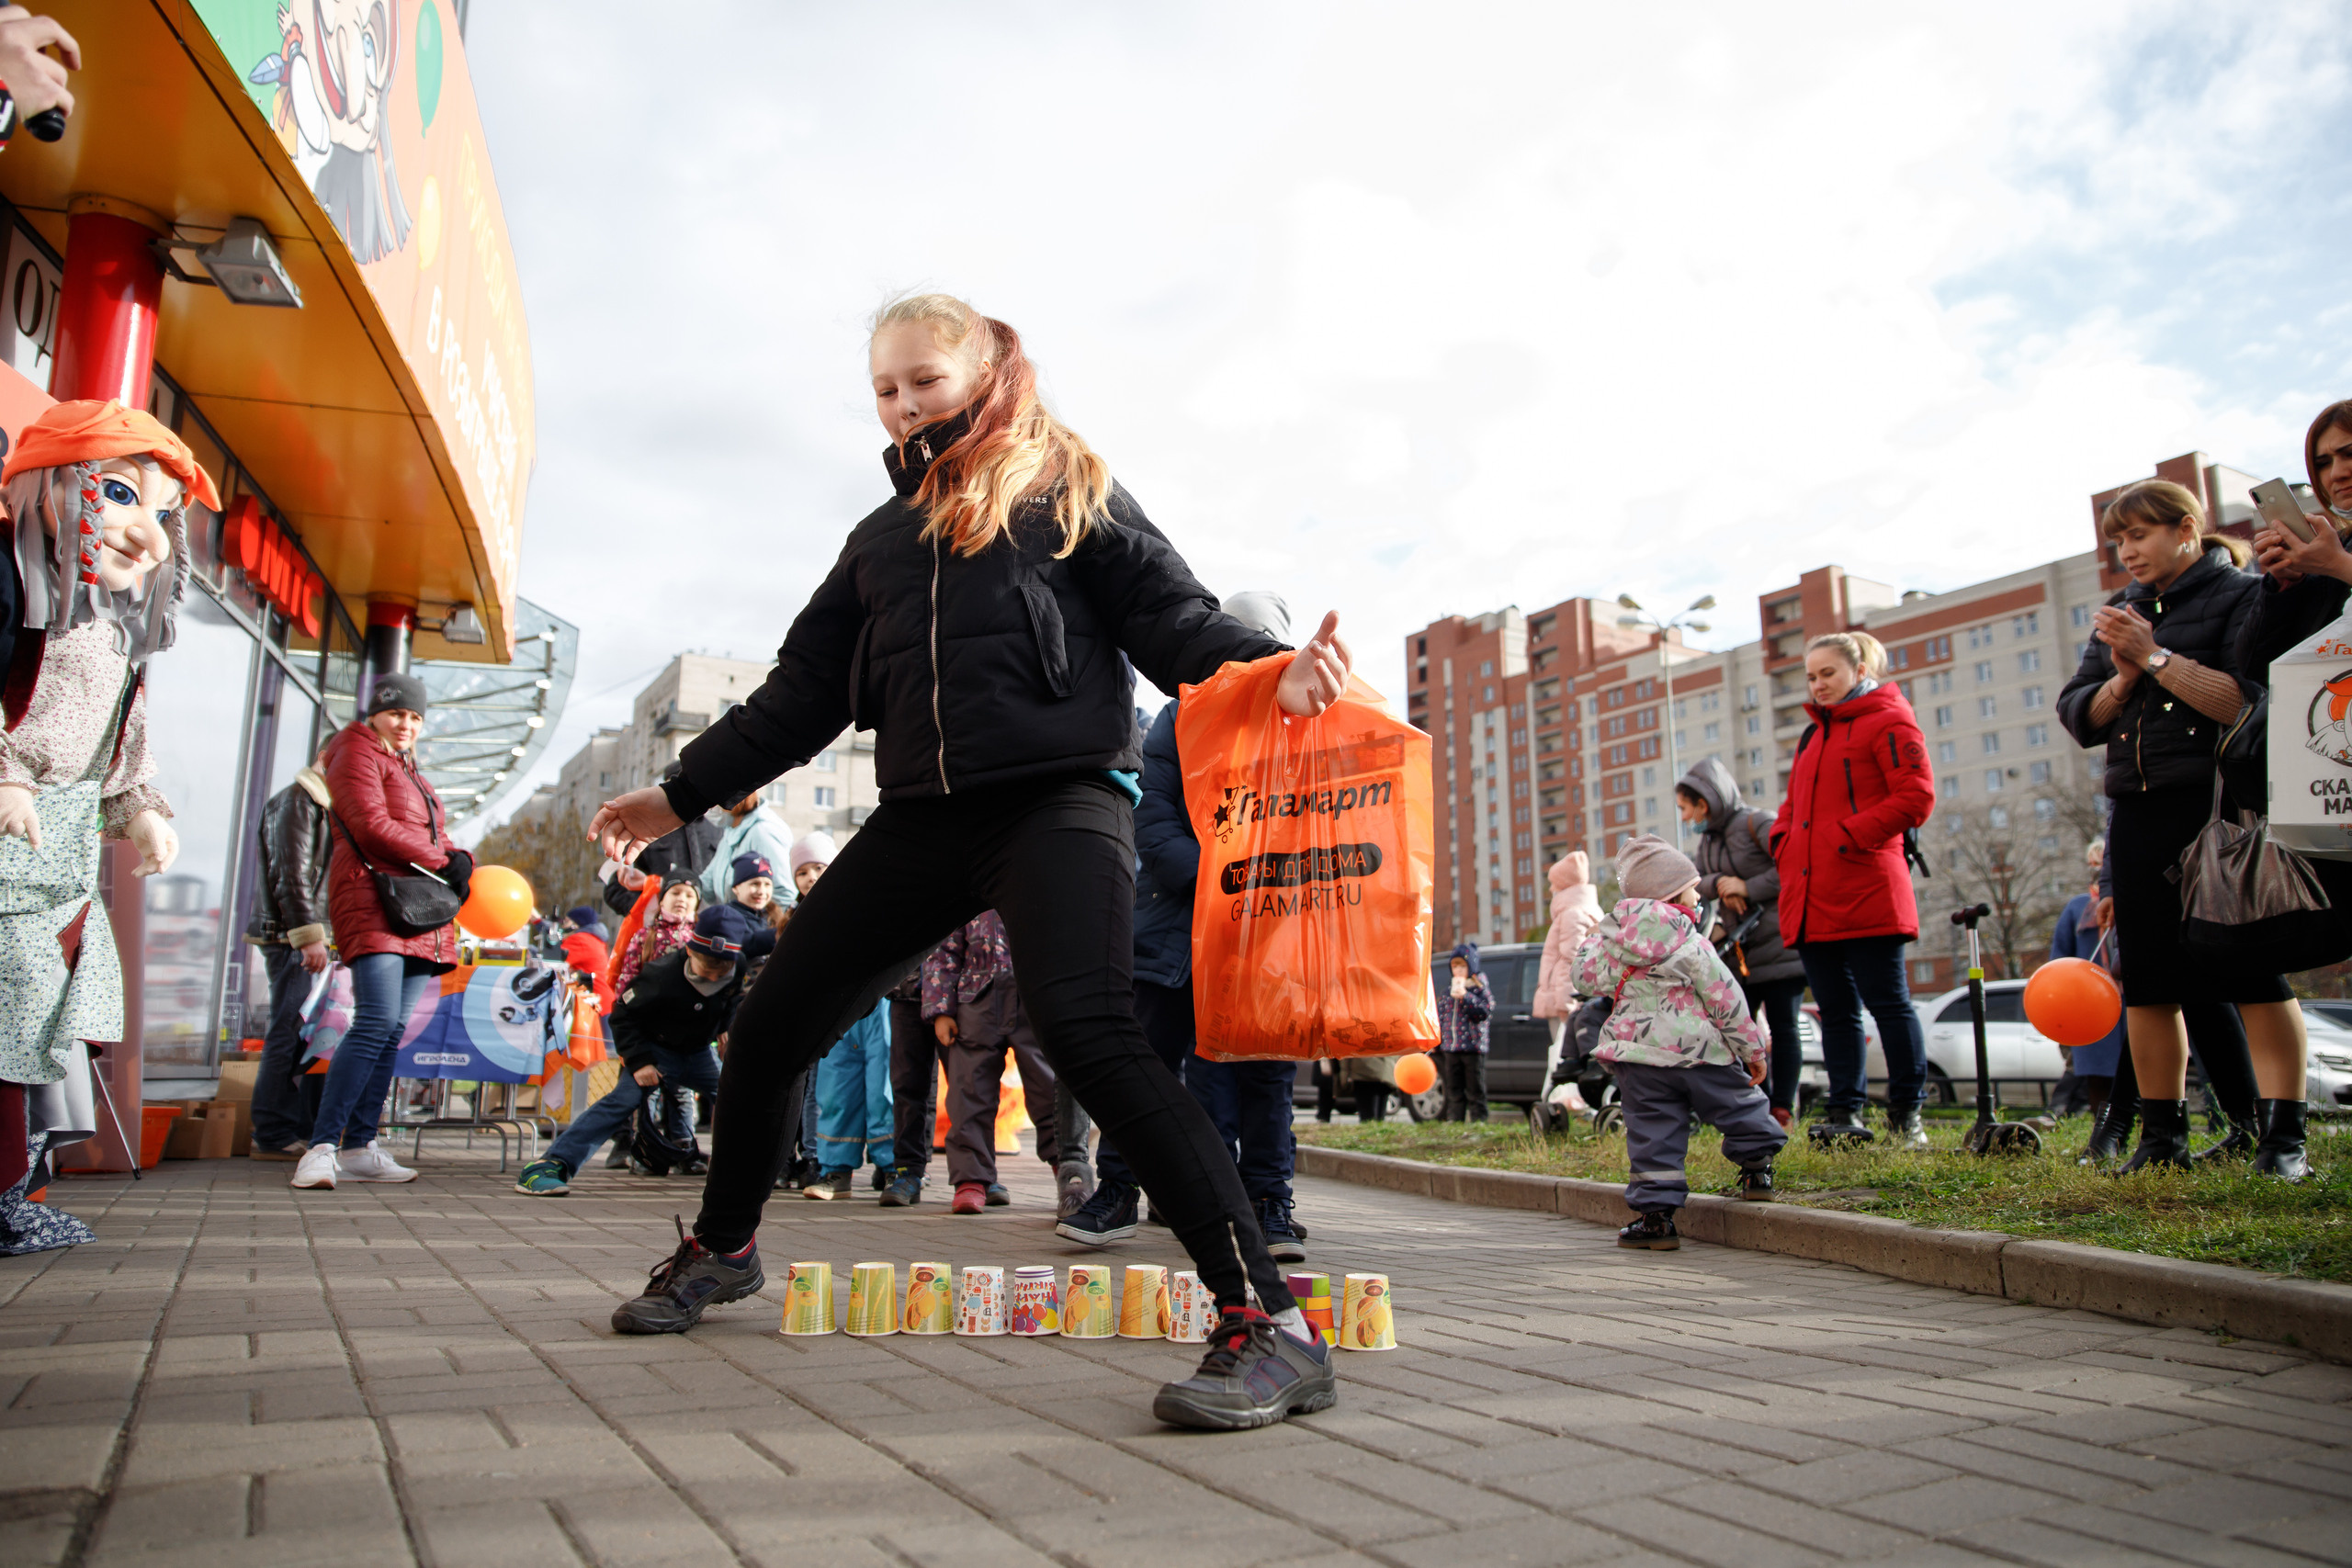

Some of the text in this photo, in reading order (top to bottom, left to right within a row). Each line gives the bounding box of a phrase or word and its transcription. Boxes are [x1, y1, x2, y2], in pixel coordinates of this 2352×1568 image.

[426, 286, 443, 354] В
[1237, 781, 1392, 826] Галамарт
[2310, 778, 2352, 796] СКА
[1231, 852, 1367, 886] ТОВАРЫ ДЛЯ ДОМА
[1231, 883, 1362, 921] GALAMART.RU
